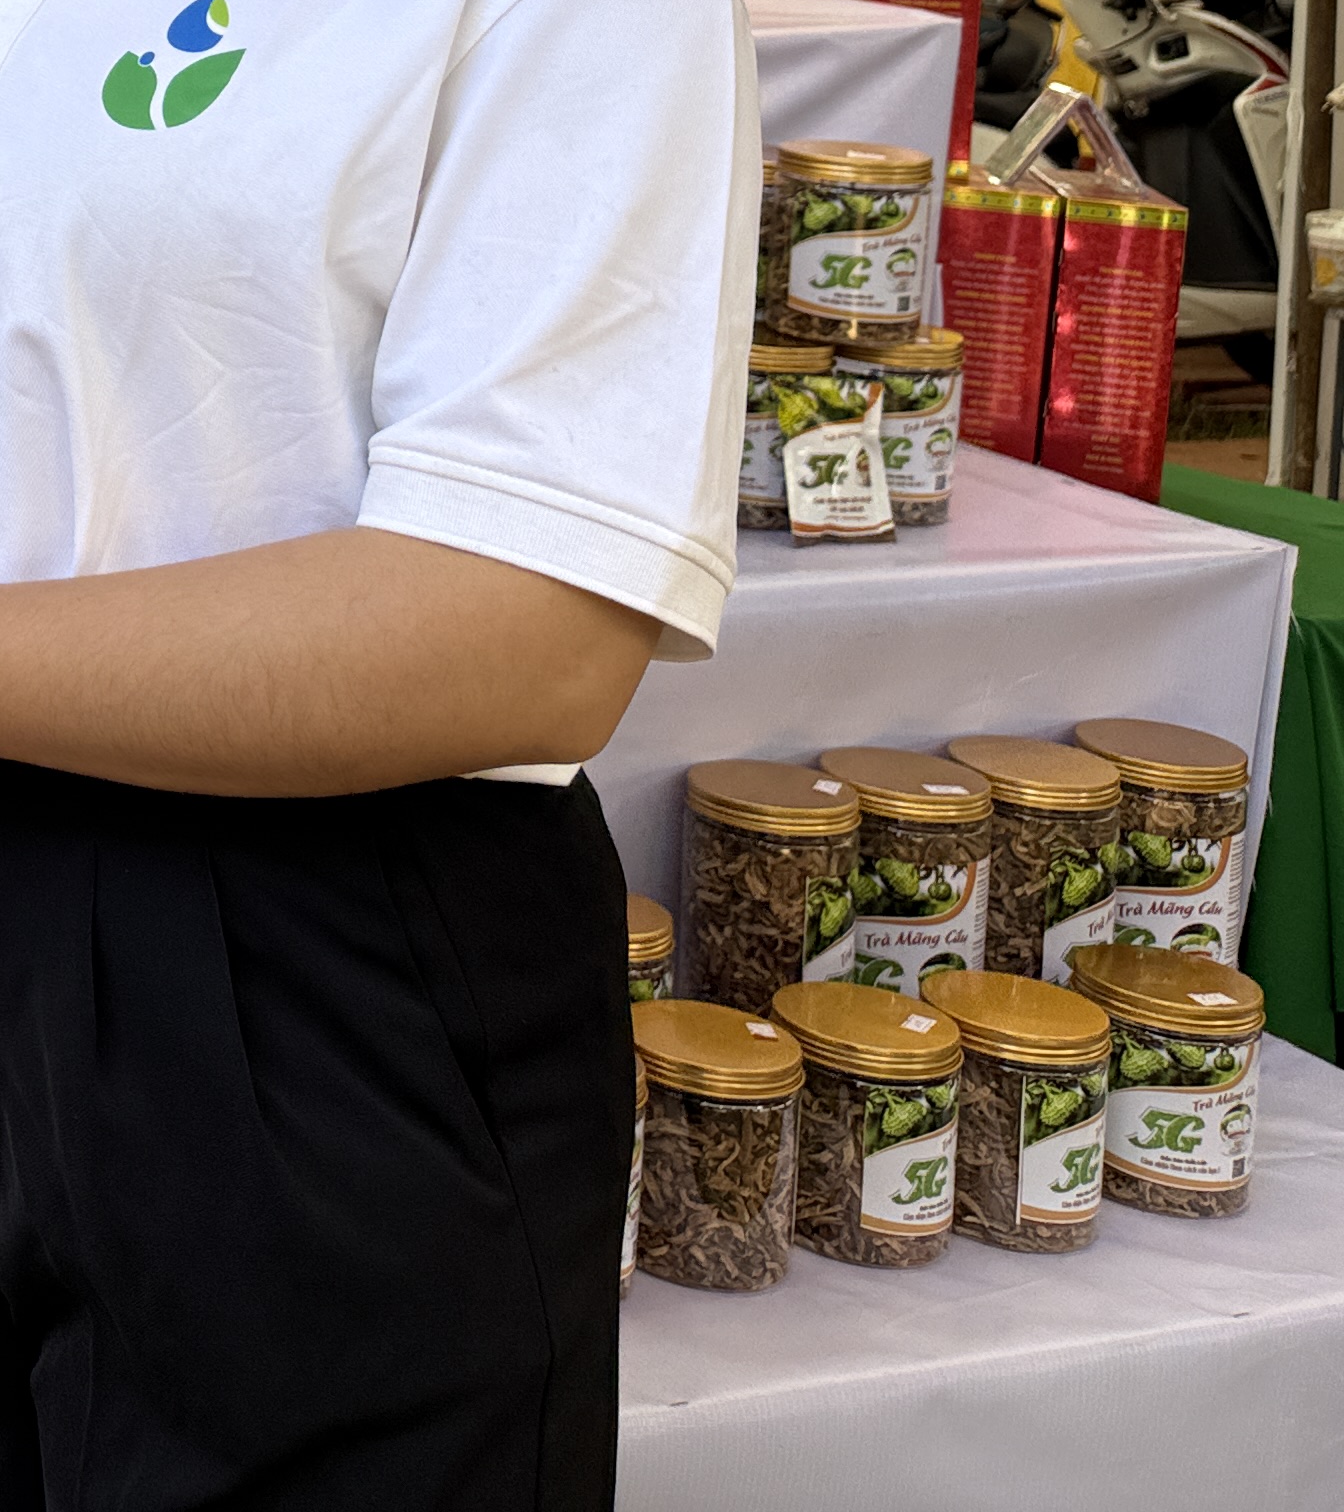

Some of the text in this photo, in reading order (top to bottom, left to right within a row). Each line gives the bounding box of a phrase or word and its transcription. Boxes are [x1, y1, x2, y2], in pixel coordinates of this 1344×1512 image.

[807, 251, 873, 290] 5G
[1116, 903, 1143, 918] Trà
[1147, 900, 1194, 918] Mãng
[865, 931, 891, 950] Trà
[894, 929, 941, 948] Mãng
[1123, 1105, 1206, 1154] 5G
[888, 1155, 949, 1206] 5G
[1048, 1142, 1101, 1194] 5G
